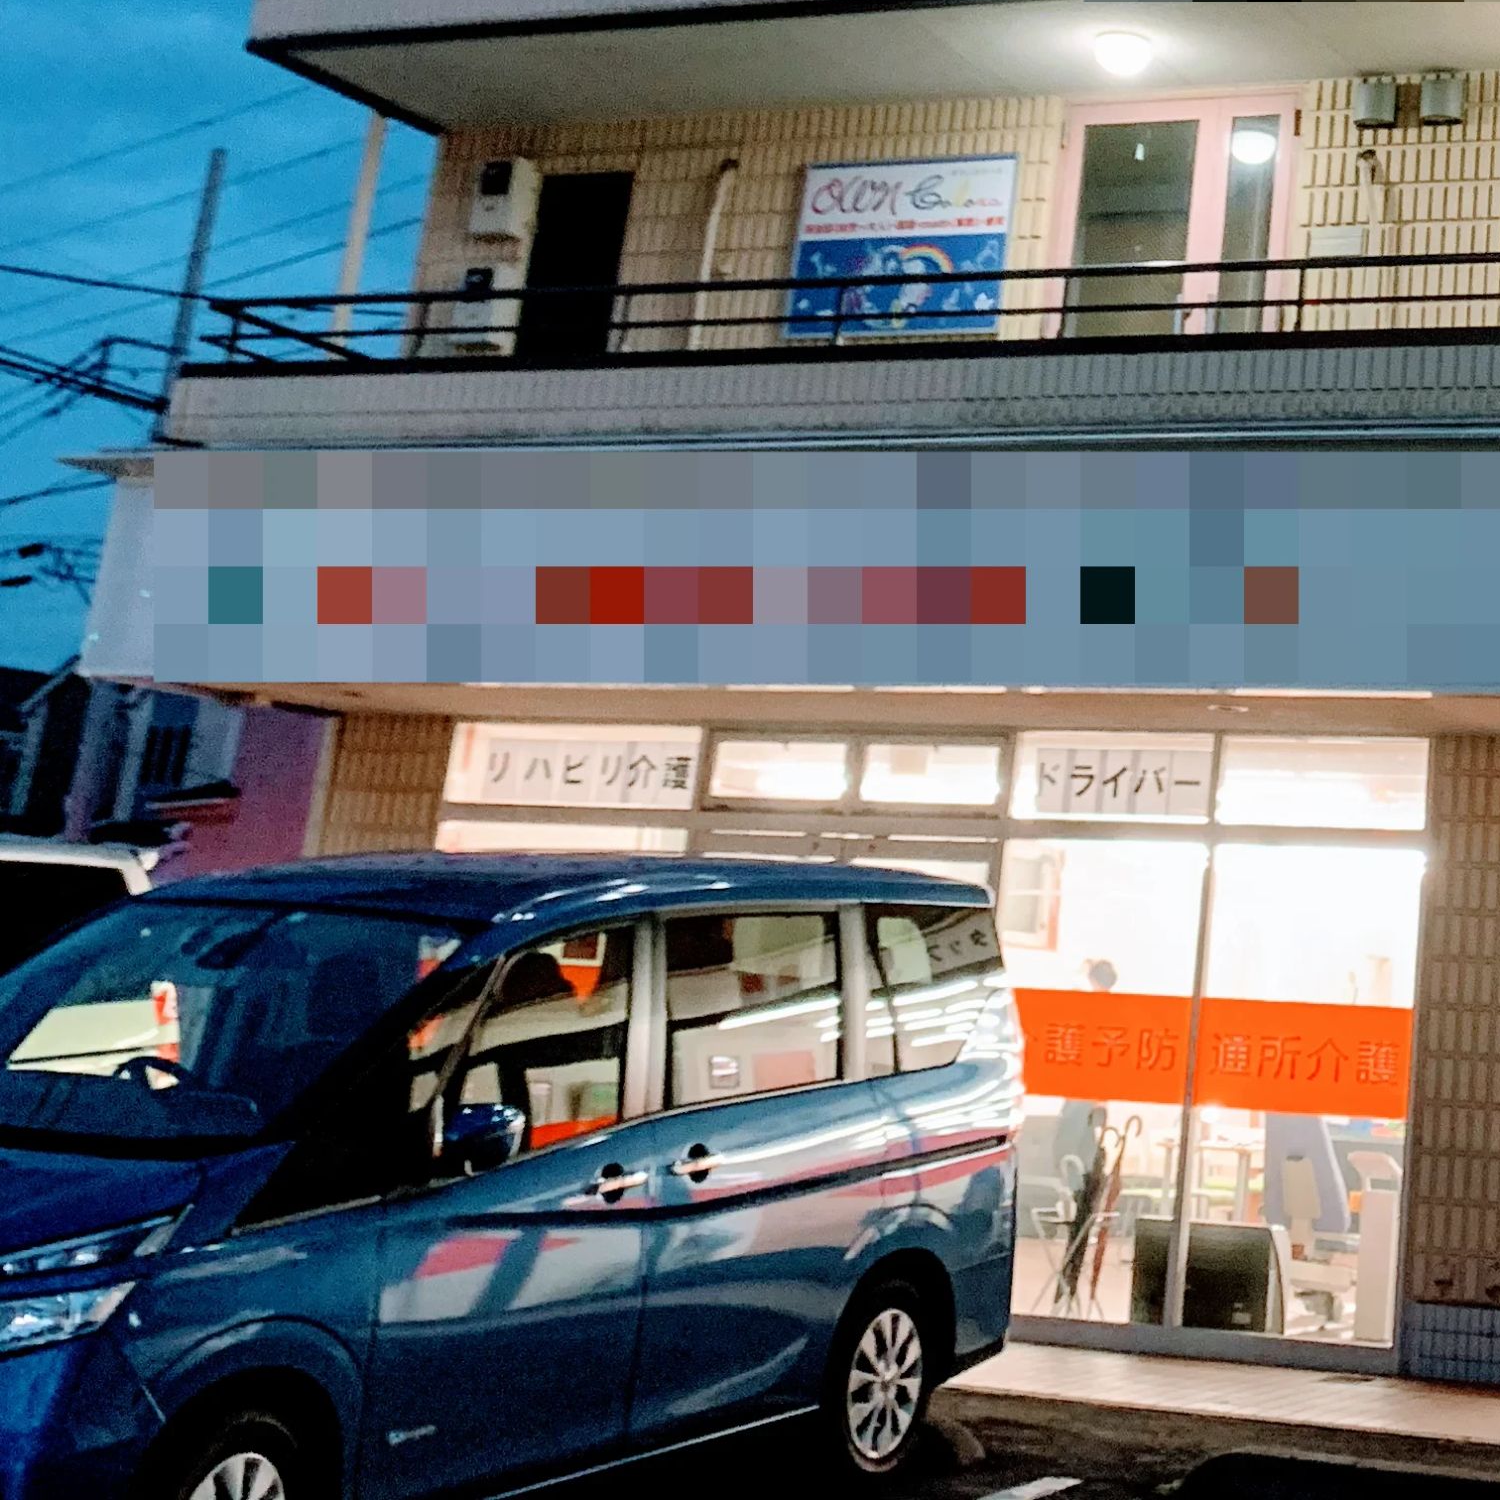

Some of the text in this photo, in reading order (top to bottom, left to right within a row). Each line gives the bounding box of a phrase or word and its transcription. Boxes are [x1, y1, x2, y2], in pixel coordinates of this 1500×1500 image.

[489, 751, 692, 789] リハビリ介護
[1039, 762, 1201, 799] ドライバー
[1026, 1023, 1180, 1072] 護予防
[1209, 1032, 1400, 1086] 通所介護
